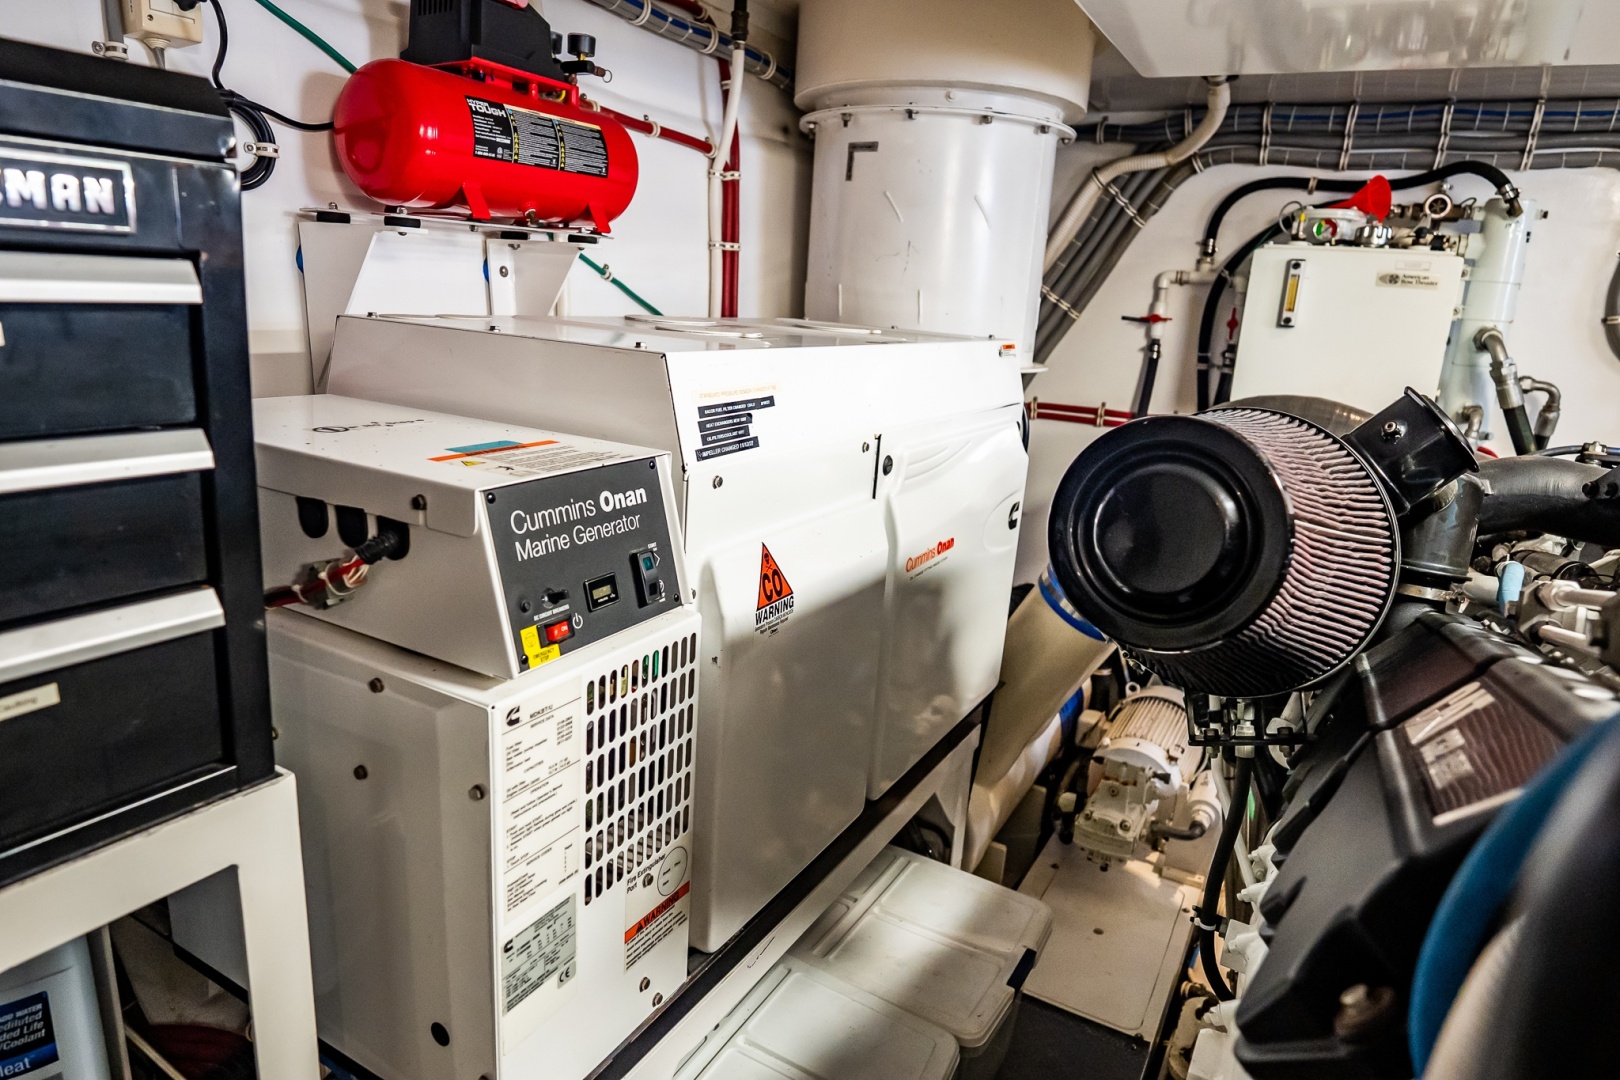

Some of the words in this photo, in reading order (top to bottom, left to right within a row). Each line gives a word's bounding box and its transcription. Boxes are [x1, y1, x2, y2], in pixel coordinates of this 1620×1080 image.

[469, 102, 507, 117] TOUGH
[0, 168, 115, 214] MAN
[510, 498, 596, 535] Cummins
[599, 487, 648, 513] Onan
[514, 533, 570, 562] Marine
[573, 514, 641, 545] Generator
[905, 547, 936, 573] Cummins
[937, 537, 955, 555] Onan
[762, 568, 783, 602] CO
[755, 595, 794, 626] WARNING
[627, 875, 637, 885] Fire
[637, 853, 666, 878] Extinguisher
[626, 883, 637, 894] Port
[643, 891, 680, 928] WARNING
[15, 1003, 43, 1018] WATER
[23, 1020, 44, 1034] Life
